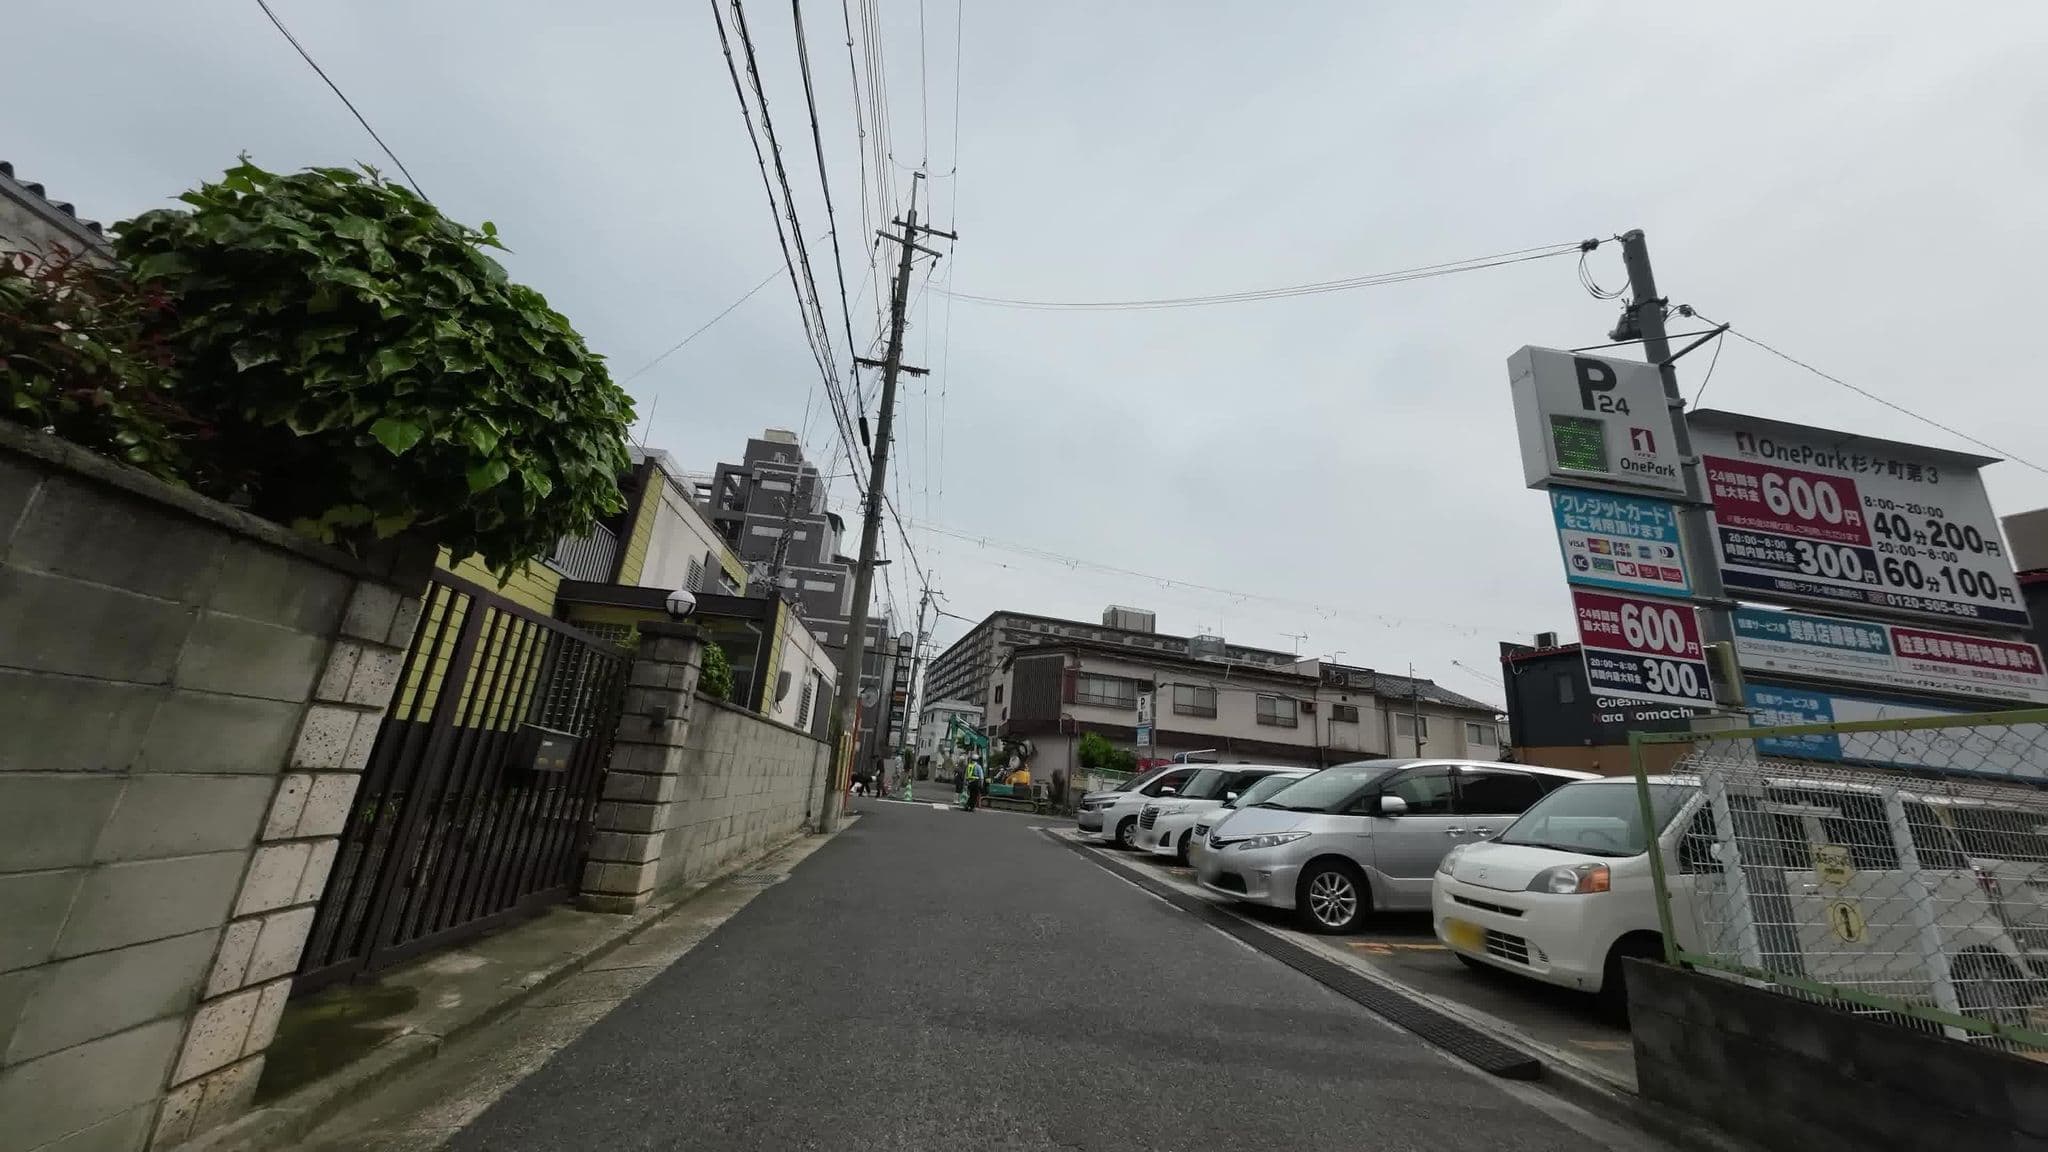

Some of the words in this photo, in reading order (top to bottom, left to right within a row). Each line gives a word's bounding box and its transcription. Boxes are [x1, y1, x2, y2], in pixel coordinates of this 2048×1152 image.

[1574, 357, 1617, 411] P
[1598, 394, 1630, 416] 24
[1620, 457, 1676, 478] OnePark
[1887, 593, 1978, 617] 0120-505-685
[1630, 706, 1695, 721] omachi
